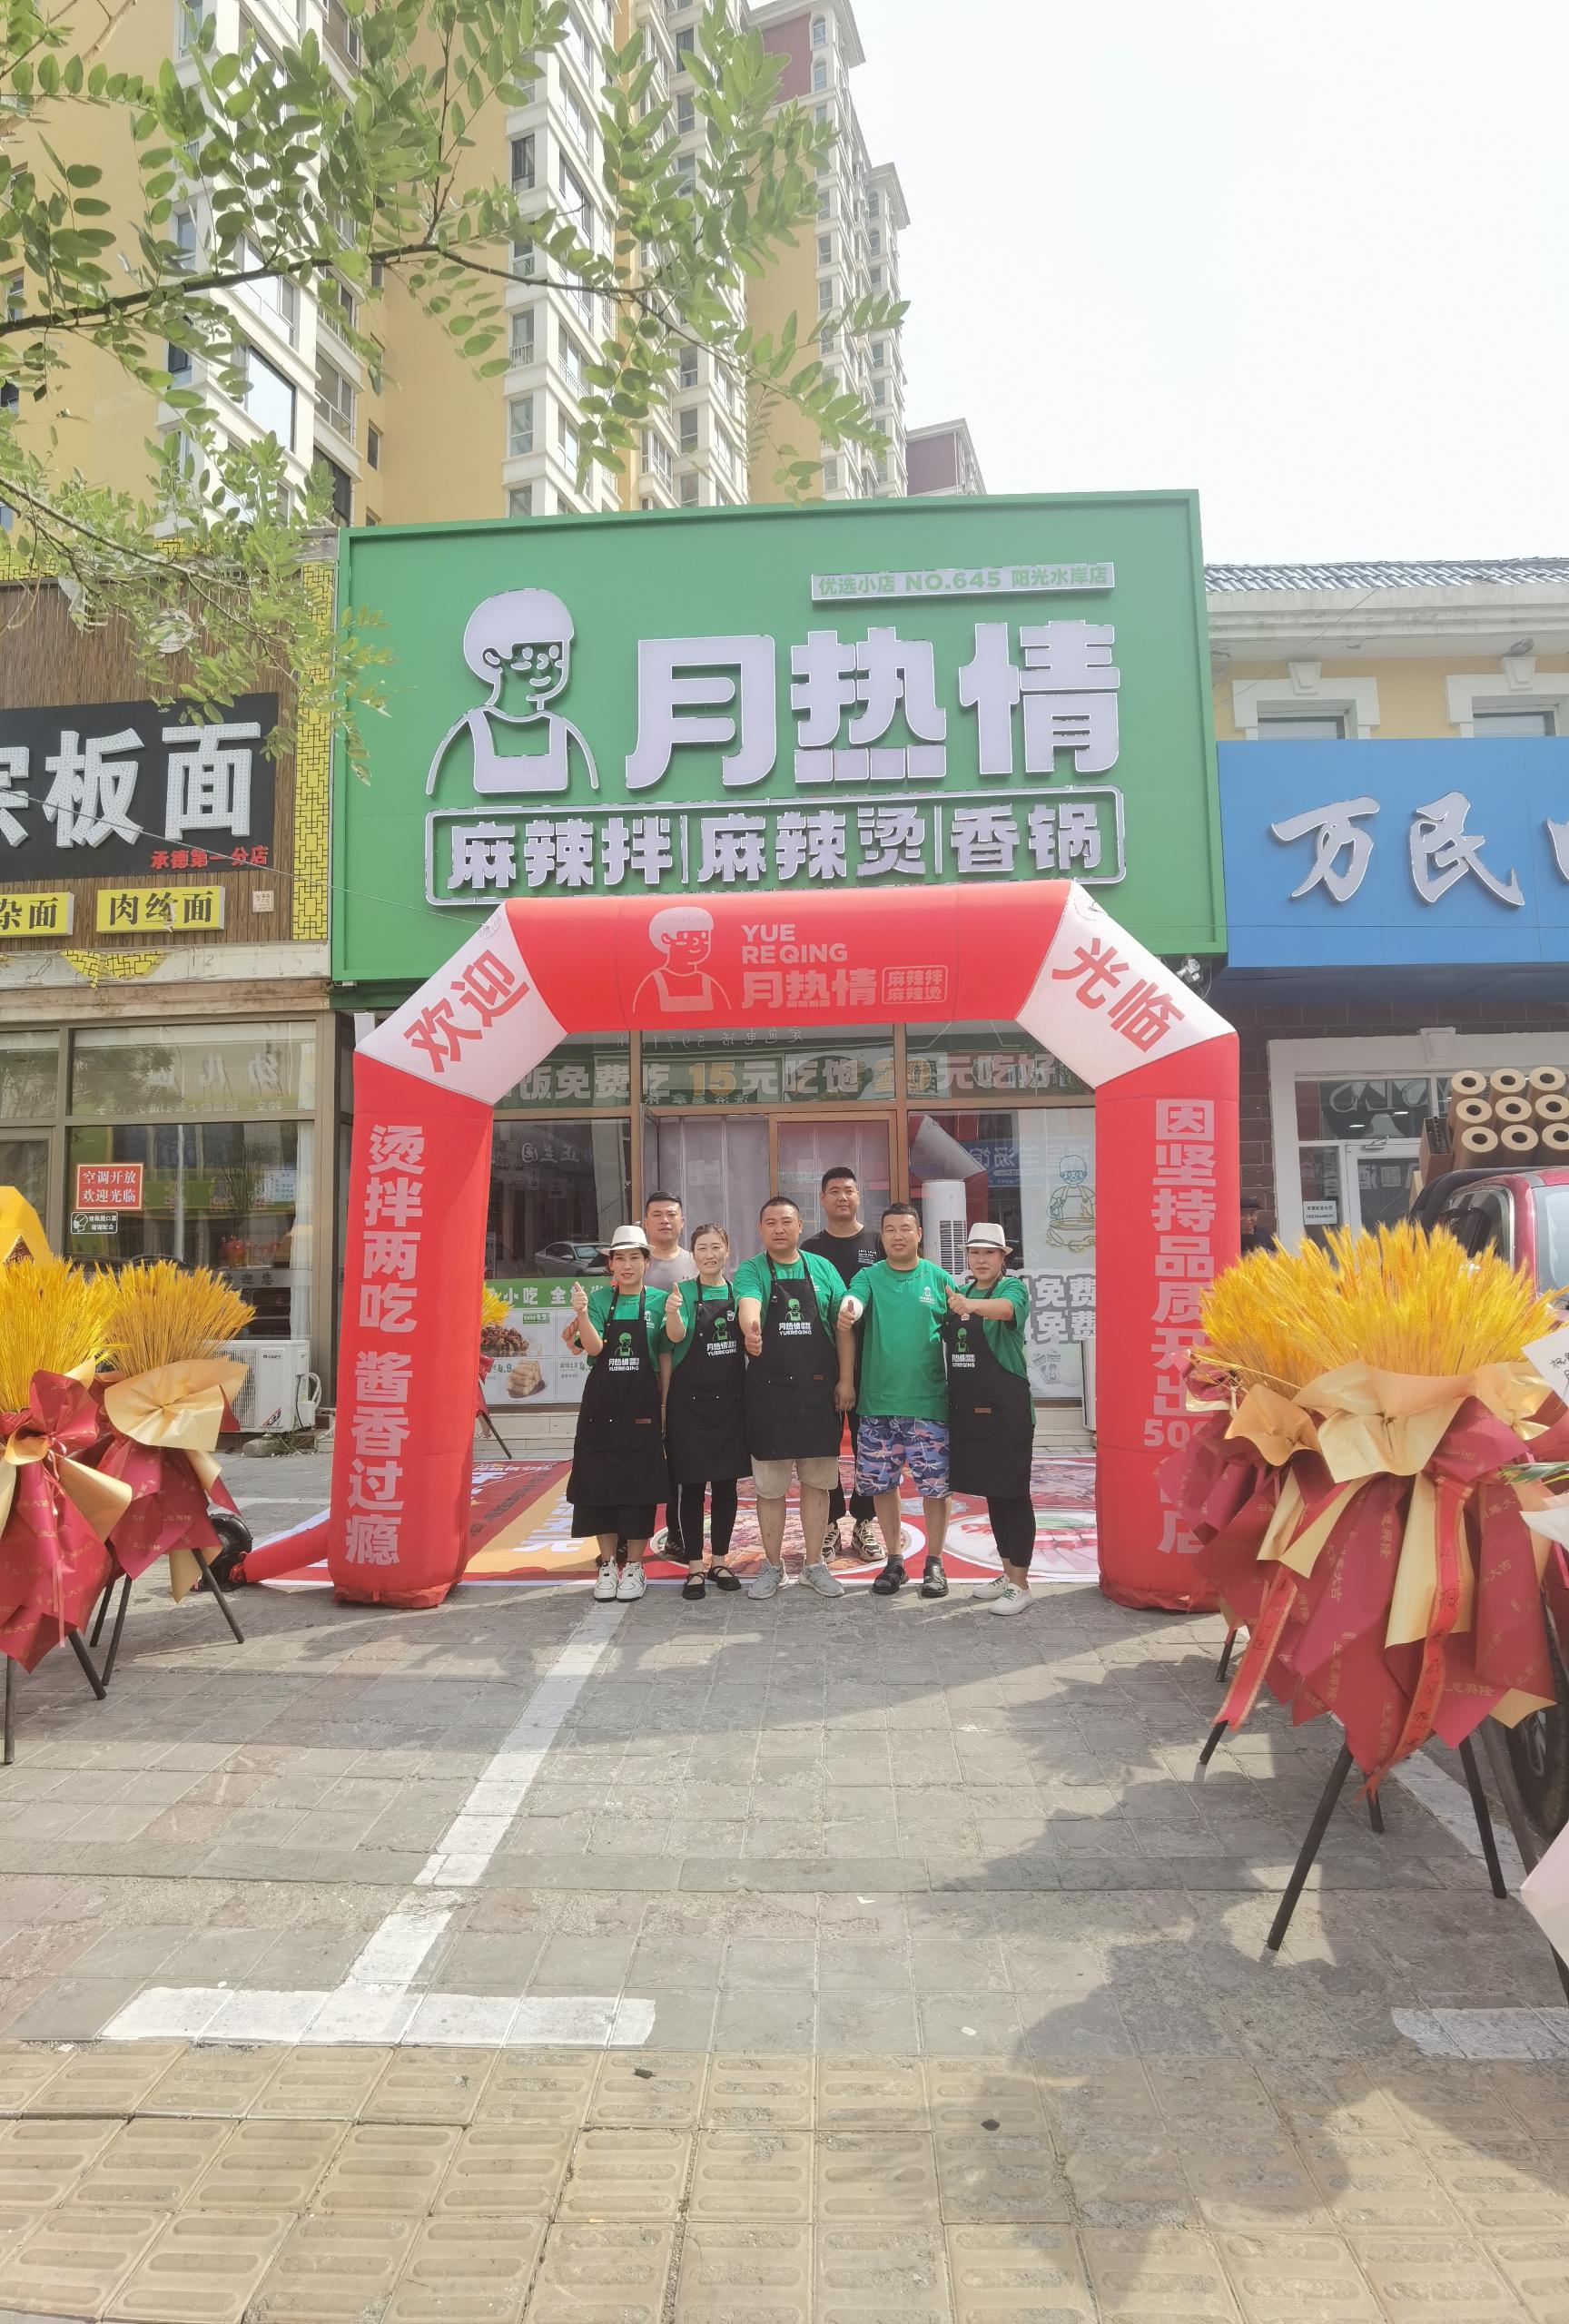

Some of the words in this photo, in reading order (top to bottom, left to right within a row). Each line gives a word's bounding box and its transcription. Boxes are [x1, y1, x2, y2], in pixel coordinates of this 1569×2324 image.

[819, 575, 895, 596] 优选小店
[904, 572, 1002, 592] NO.645
[1011, 566, 1108, 587] 阳光水岸店
[626, 619, 1120, 789] 月热情
[151, 845, 269, 870] 承德第一分店
[448, 817, 672, 889] 麻辣拌
[697, 805, 926, 883] 麻辣烫
[951, 803, 1101, 872] 香锅
[1270, 791, 1569, 906] 万民
[741, 924, 795, 941] YUE
[403, 950, 530, 1073] 欢迎
[1051, 937, 1186, 1053] 光临
[741, 968, 877, 1009] 月热情
[83, 1170, 136, 1184] 空调开放
[83, 1188, 135, 1203] 欢迎光临
[359, 1125, 426, 1334] 烫拌两吃
[1025, 1277, 1096, 1308] 免费
[1024, 1311, 1096, 1341] 免费
[345, 1350, 414, 1567] 酱香过瘾
